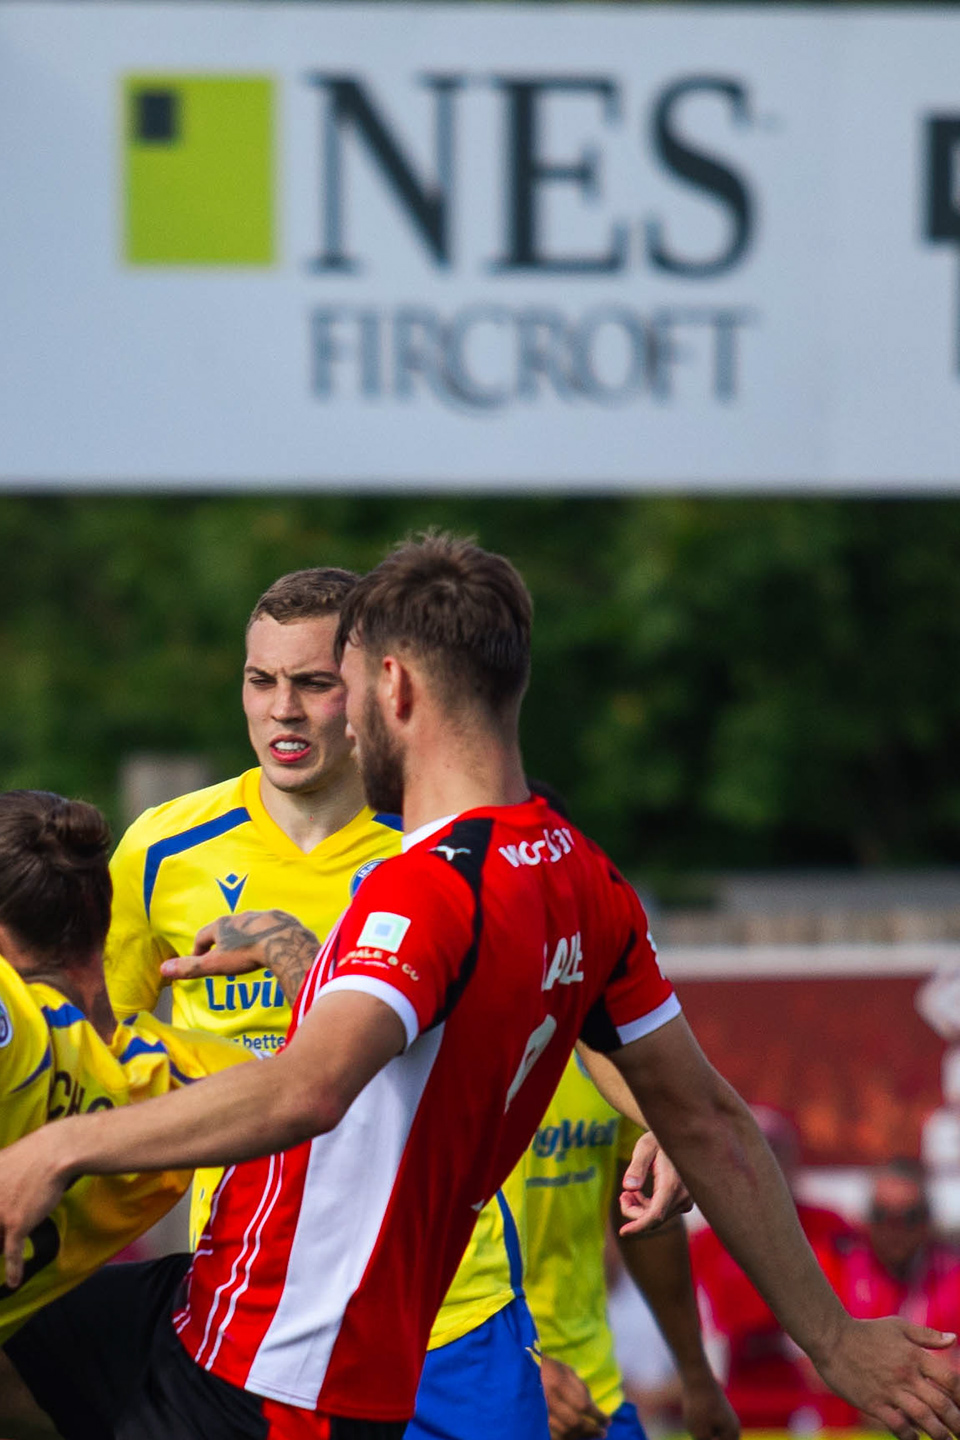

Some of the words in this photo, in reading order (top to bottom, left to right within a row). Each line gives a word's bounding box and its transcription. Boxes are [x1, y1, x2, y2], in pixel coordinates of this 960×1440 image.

[302, 70, 760, 280] NES
[306, 302, 758, 416] FIRCROFT
[242, 1033, 287, 1051] bette
